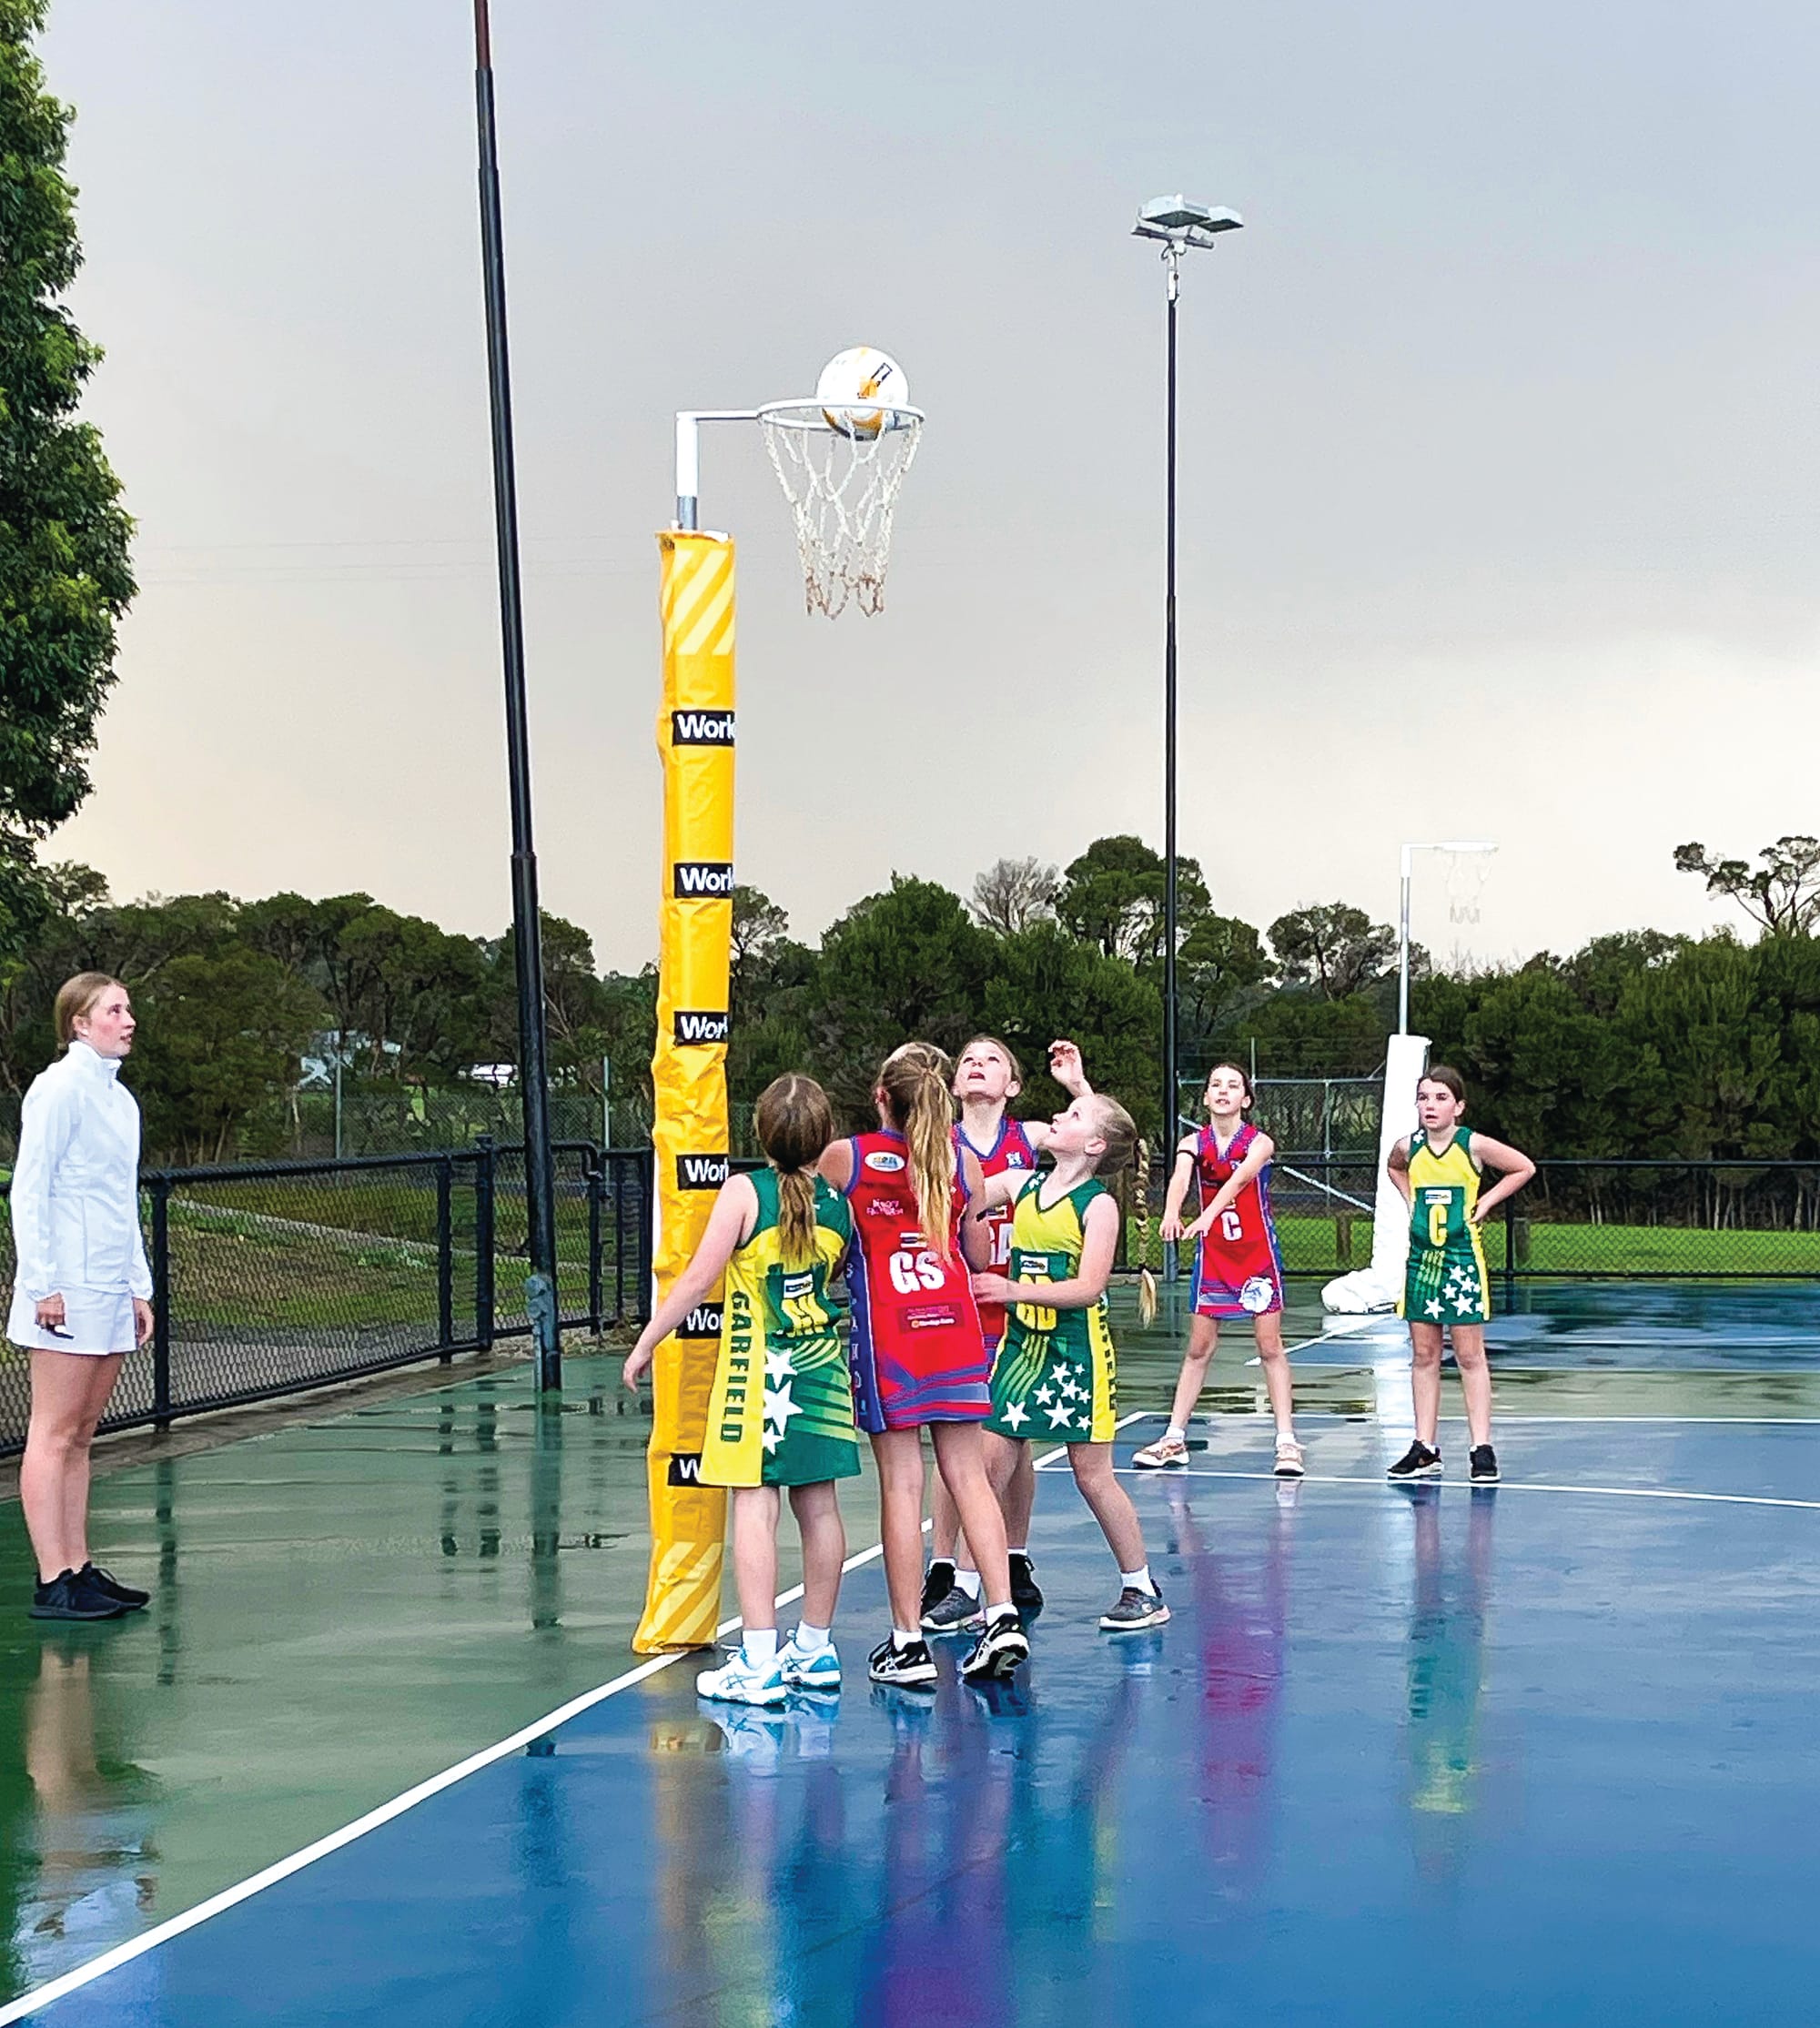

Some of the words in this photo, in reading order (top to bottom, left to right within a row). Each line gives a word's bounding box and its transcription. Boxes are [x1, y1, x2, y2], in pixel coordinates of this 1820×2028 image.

[1220, 1209, 1243, 1241] C
[1430, 1204, 1448, 1246] C
[889, 1251, 945, 1294] GS
[720, 1291, 752, 1443] GARFIELD
